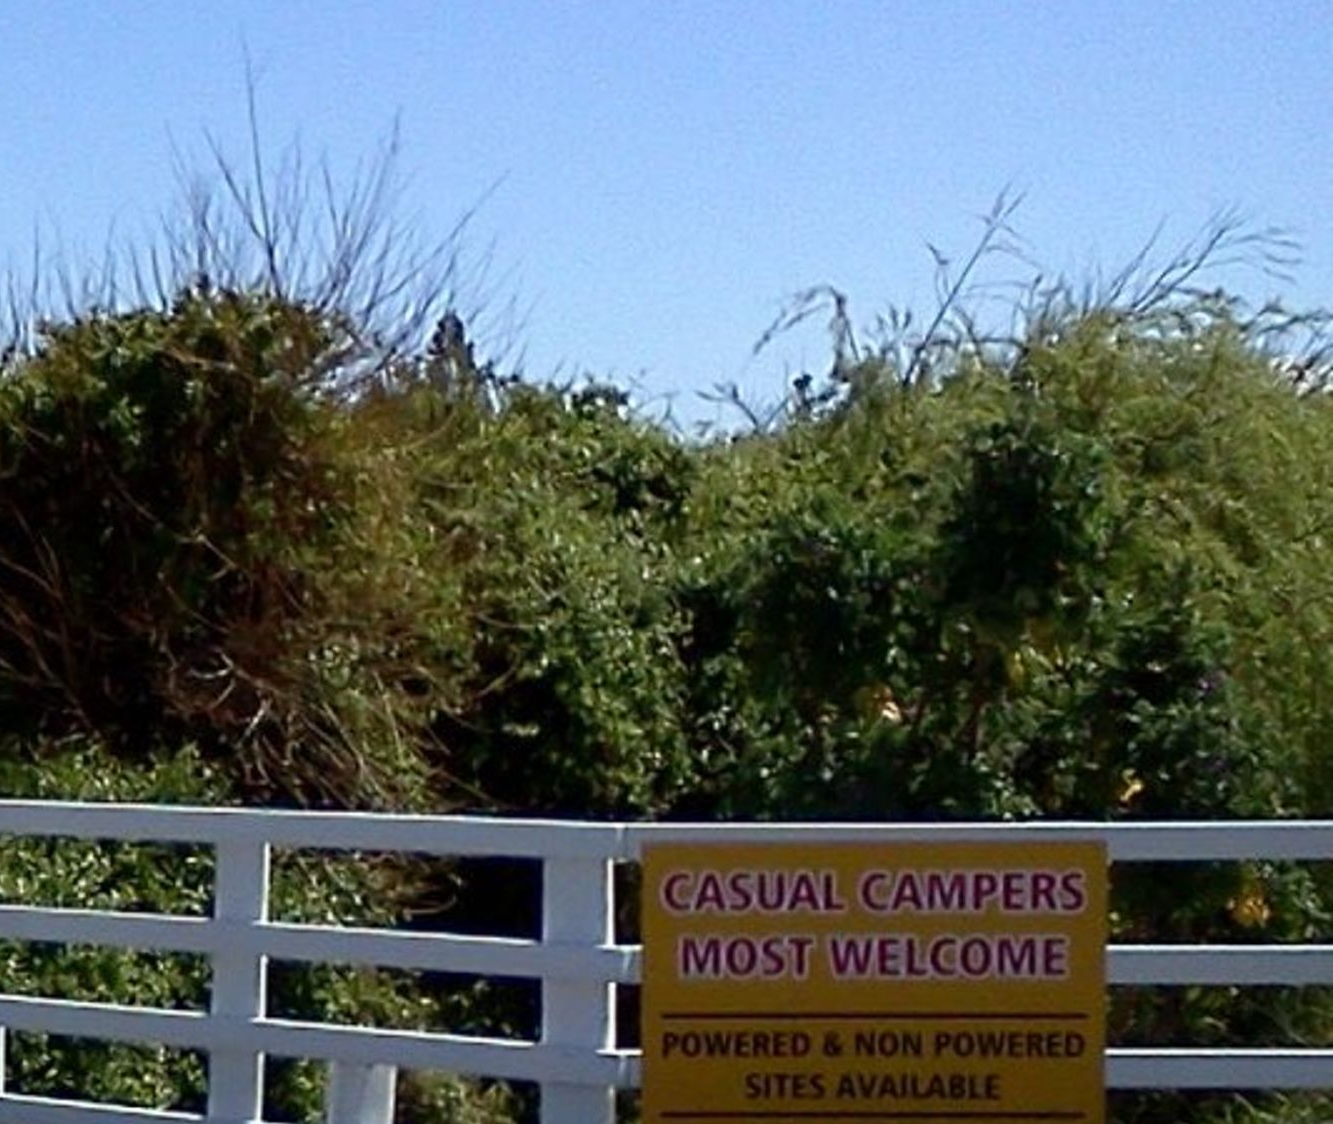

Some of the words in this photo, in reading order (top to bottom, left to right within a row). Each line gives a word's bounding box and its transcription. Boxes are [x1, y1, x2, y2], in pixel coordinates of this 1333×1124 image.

[663, 871, 845, 913] CASUAL
[861, 871, 1086, 912] CAMPERS
[681, 936, 814, 977] MOST
[830, 936, 1067, 977] WELCOME
[662, 1031, 811, 1059] POWERED
[822, 1031, 842, 1059] &
[854, 1031, 923, 1059] NON
[935, 1031, 1086, 1059] POWERED
[745, 1072, 825, 1100] SITES
[836, 1072, 1002, 1100] AVAILABLE
